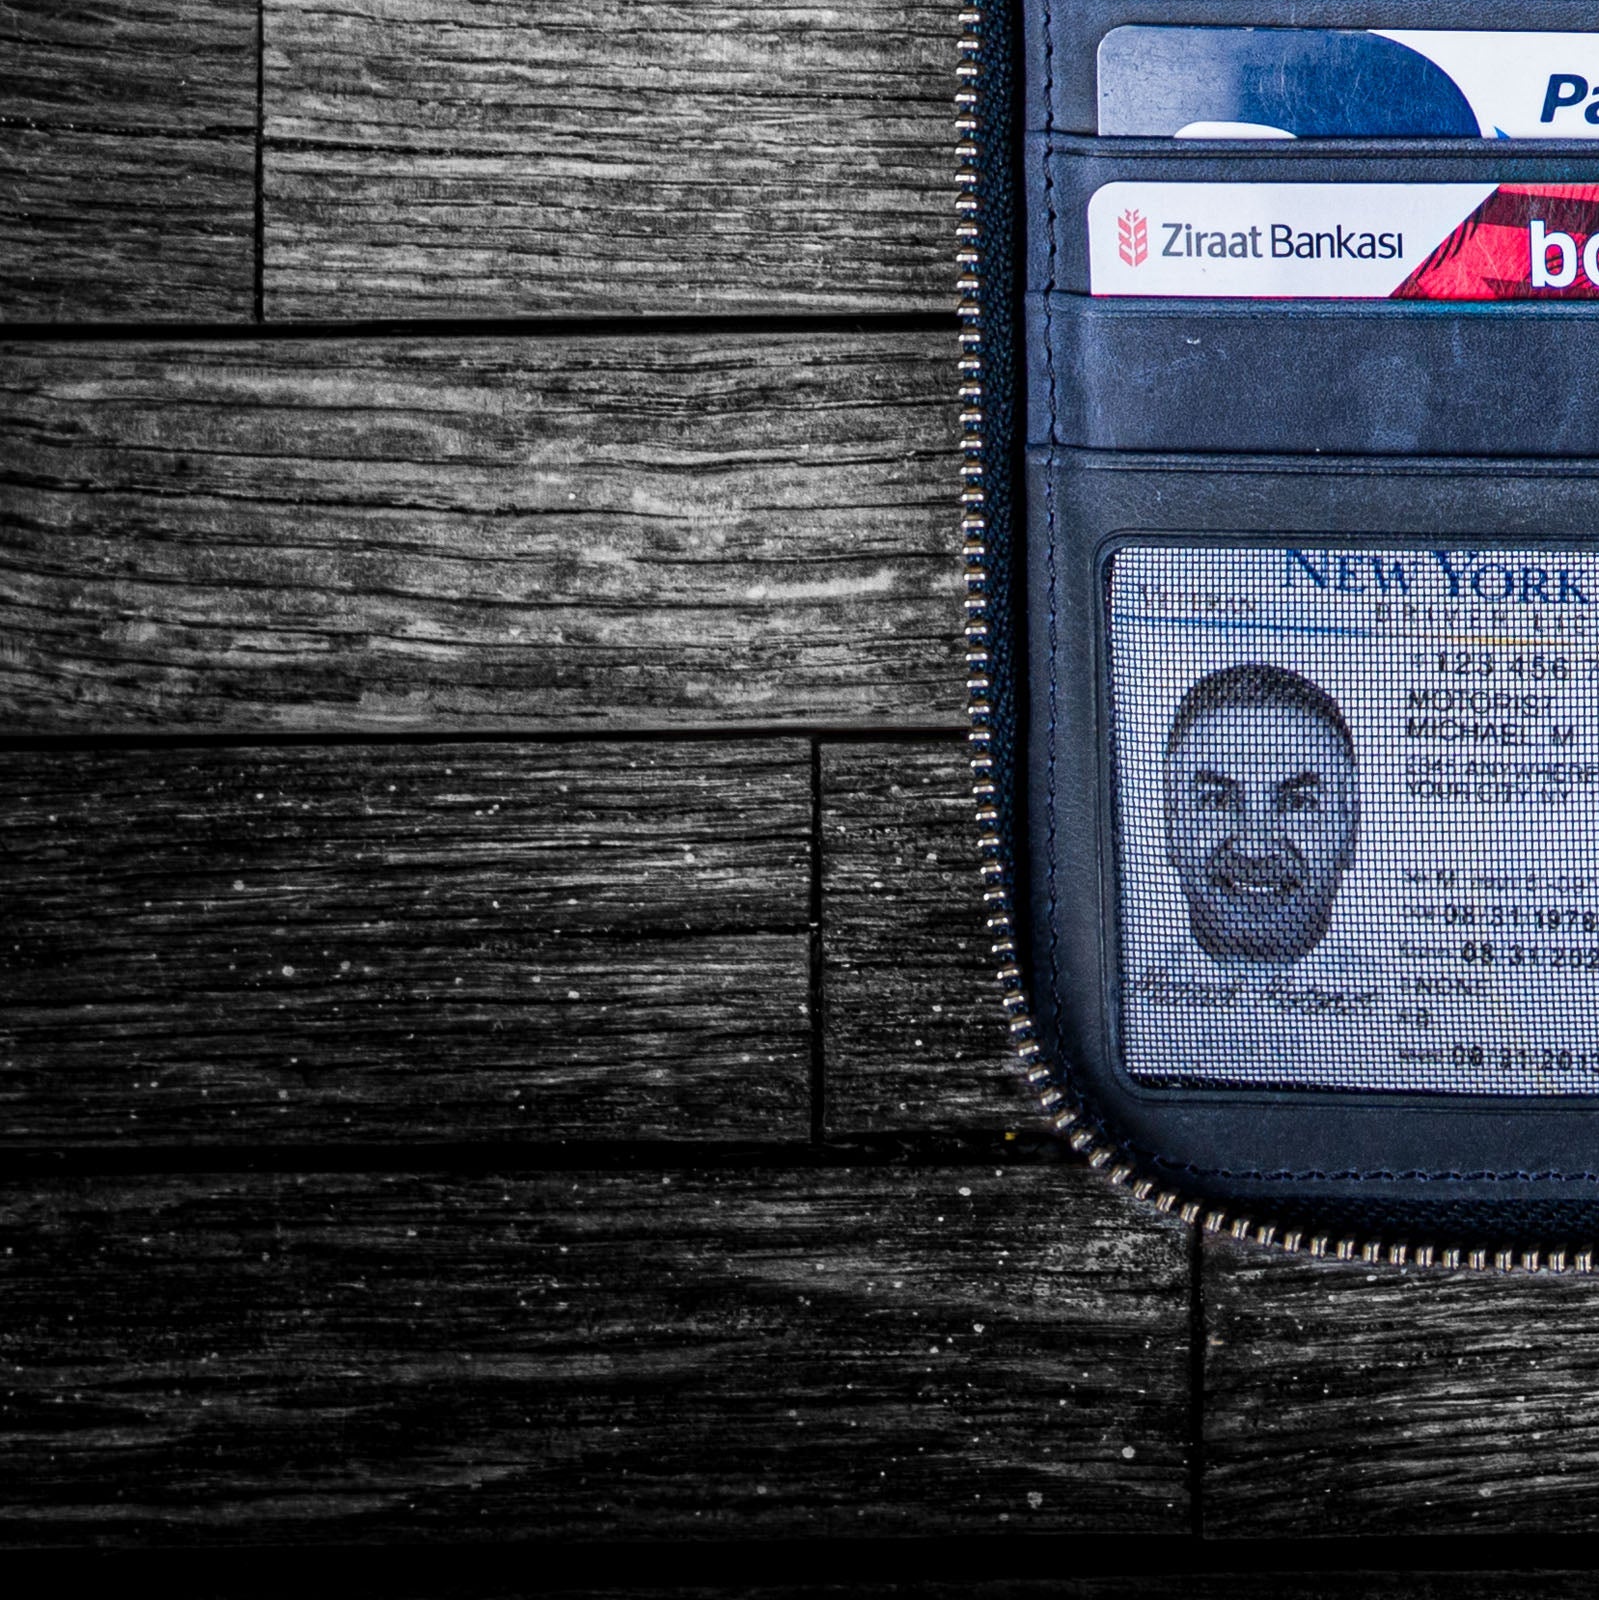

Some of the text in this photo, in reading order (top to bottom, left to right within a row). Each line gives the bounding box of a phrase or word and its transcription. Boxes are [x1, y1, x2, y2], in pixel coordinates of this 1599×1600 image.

[1160, 221, 1404, 260] Ziraat Bankası
[1283, 549, 1414, 595] NEW
[1435, 549, 1589, 605] YORK
[1438, 652, 1494, 677] 123
[1512, 655, 1569, 680] 456
[1407, 689, 1554, 716] MOTORIST
[1406, 718, 1576, 747] MICHAEL M
